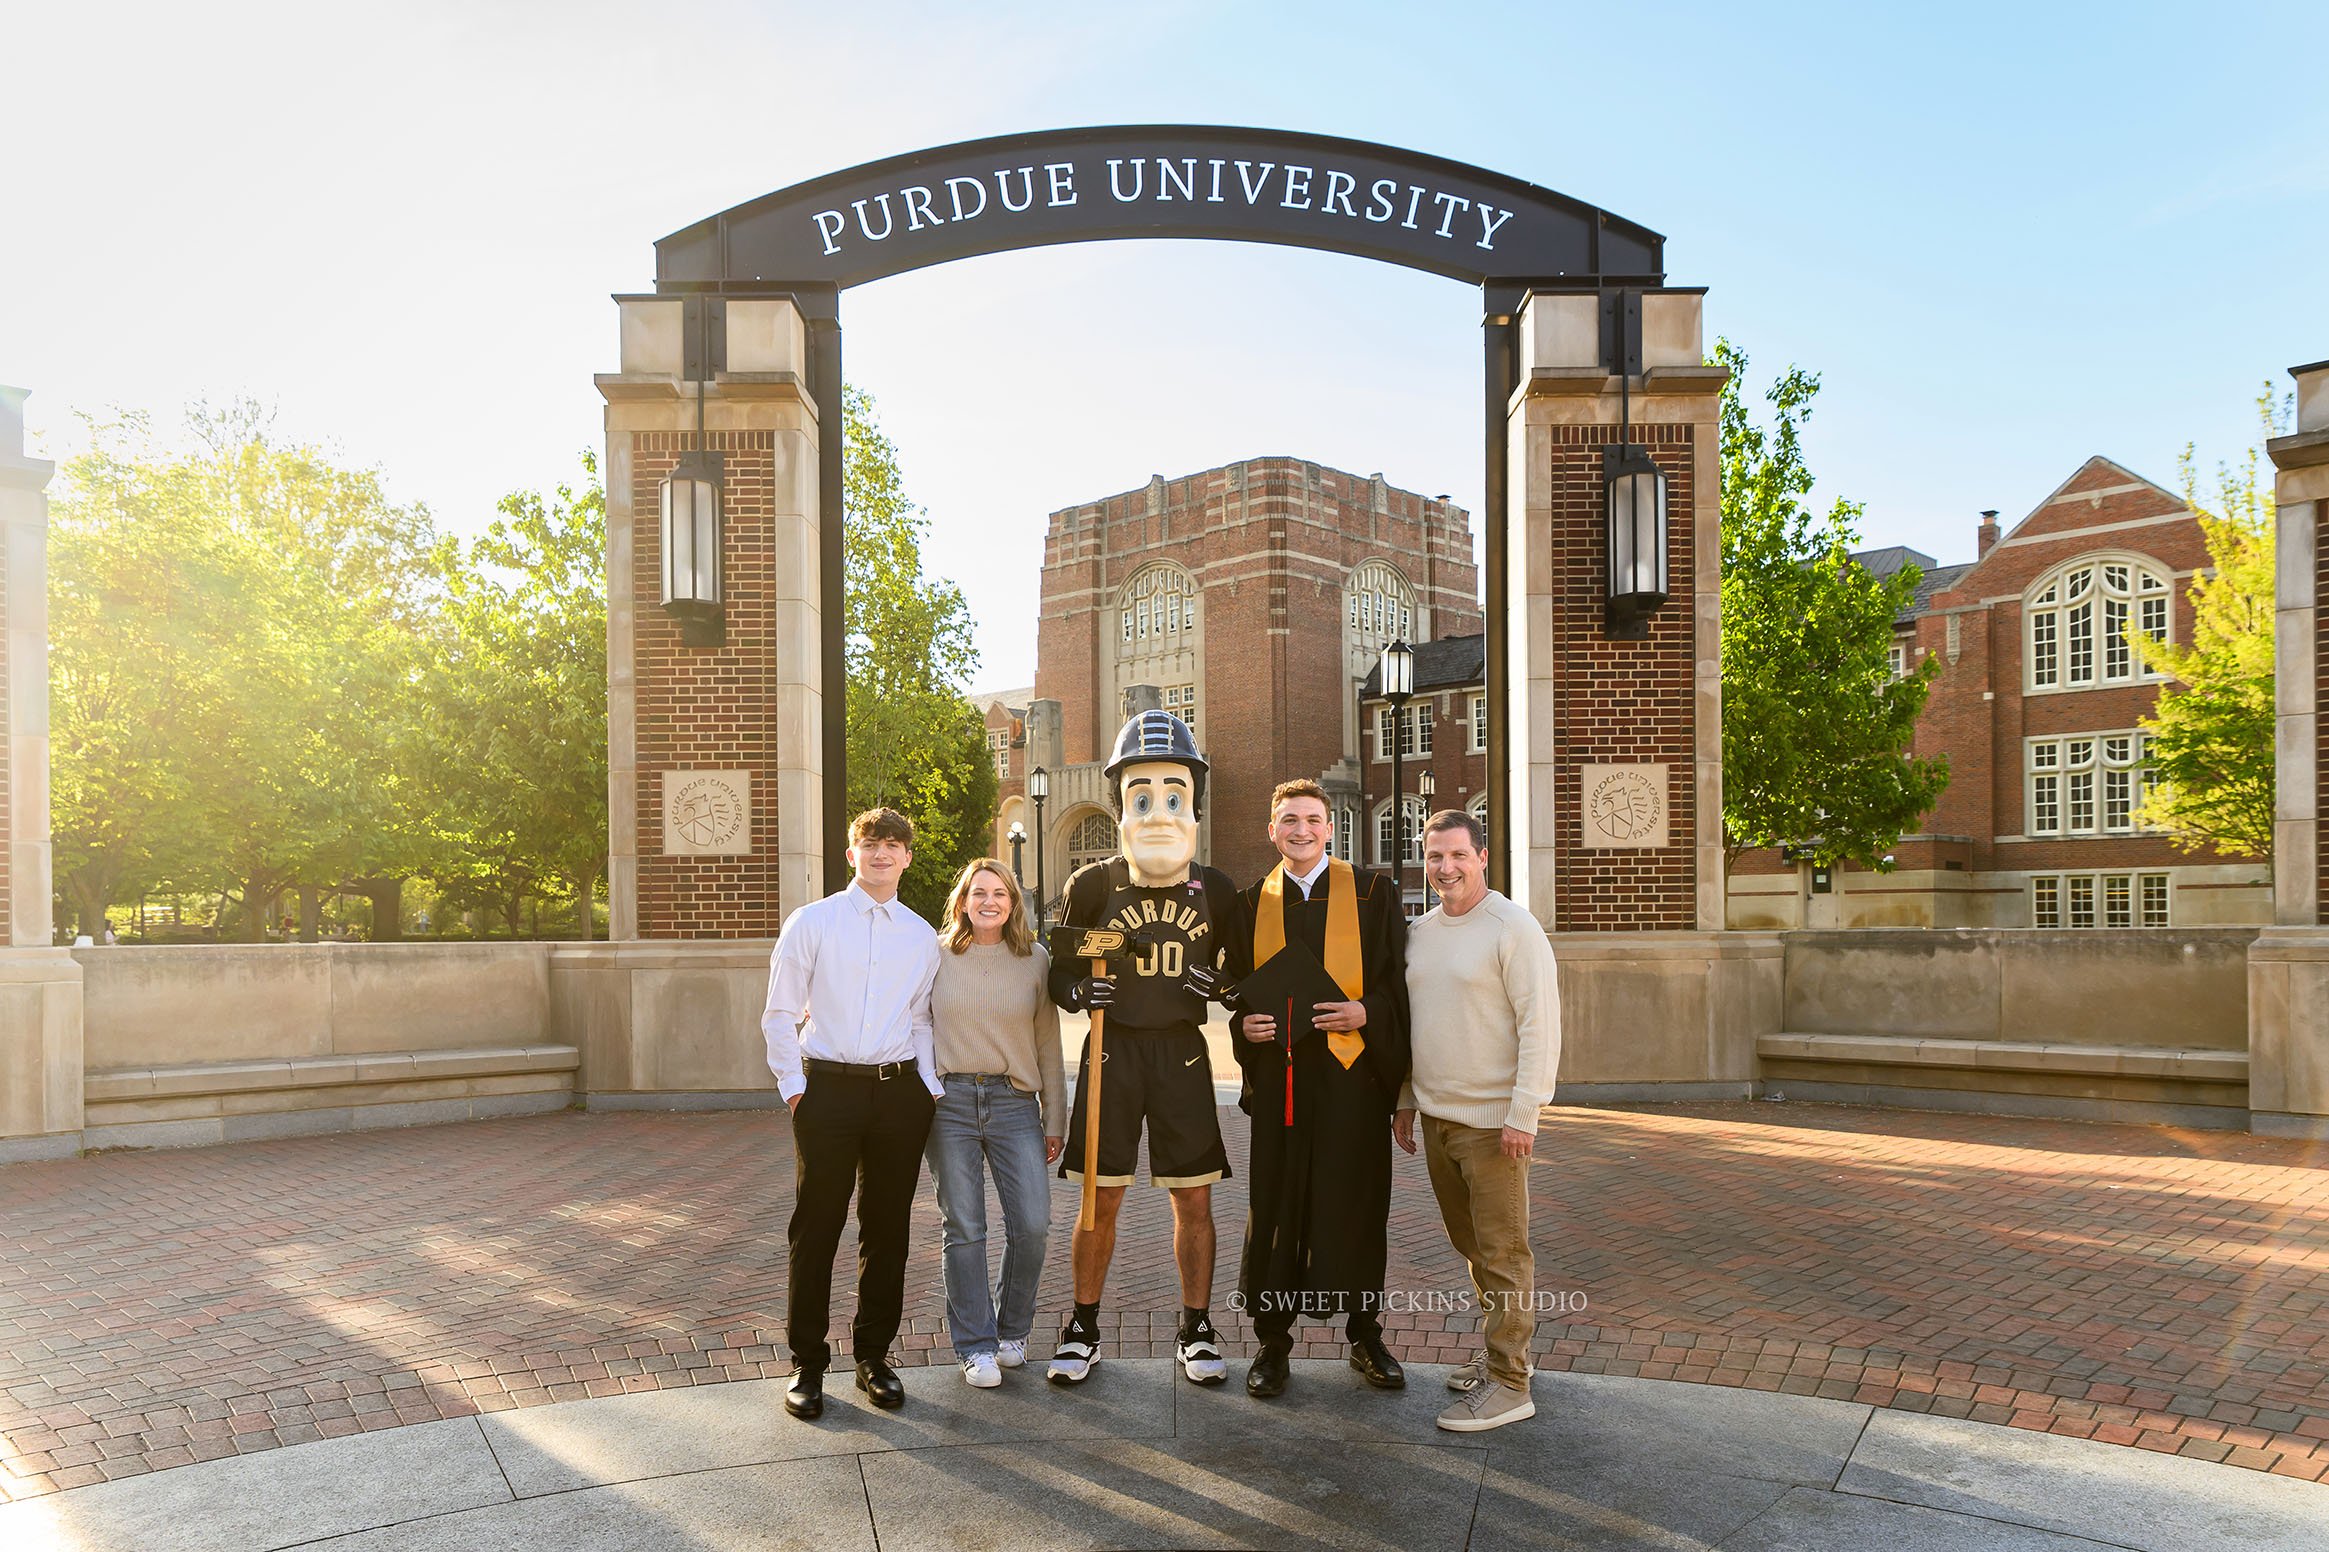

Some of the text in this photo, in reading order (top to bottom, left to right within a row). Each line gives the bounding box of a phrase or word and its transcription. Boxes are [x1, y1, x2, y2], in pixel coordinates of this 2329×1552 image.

[812, 158, 1515, 256] PURDUE UNIVERSITY
[1076, 930, 1125, 957] P
